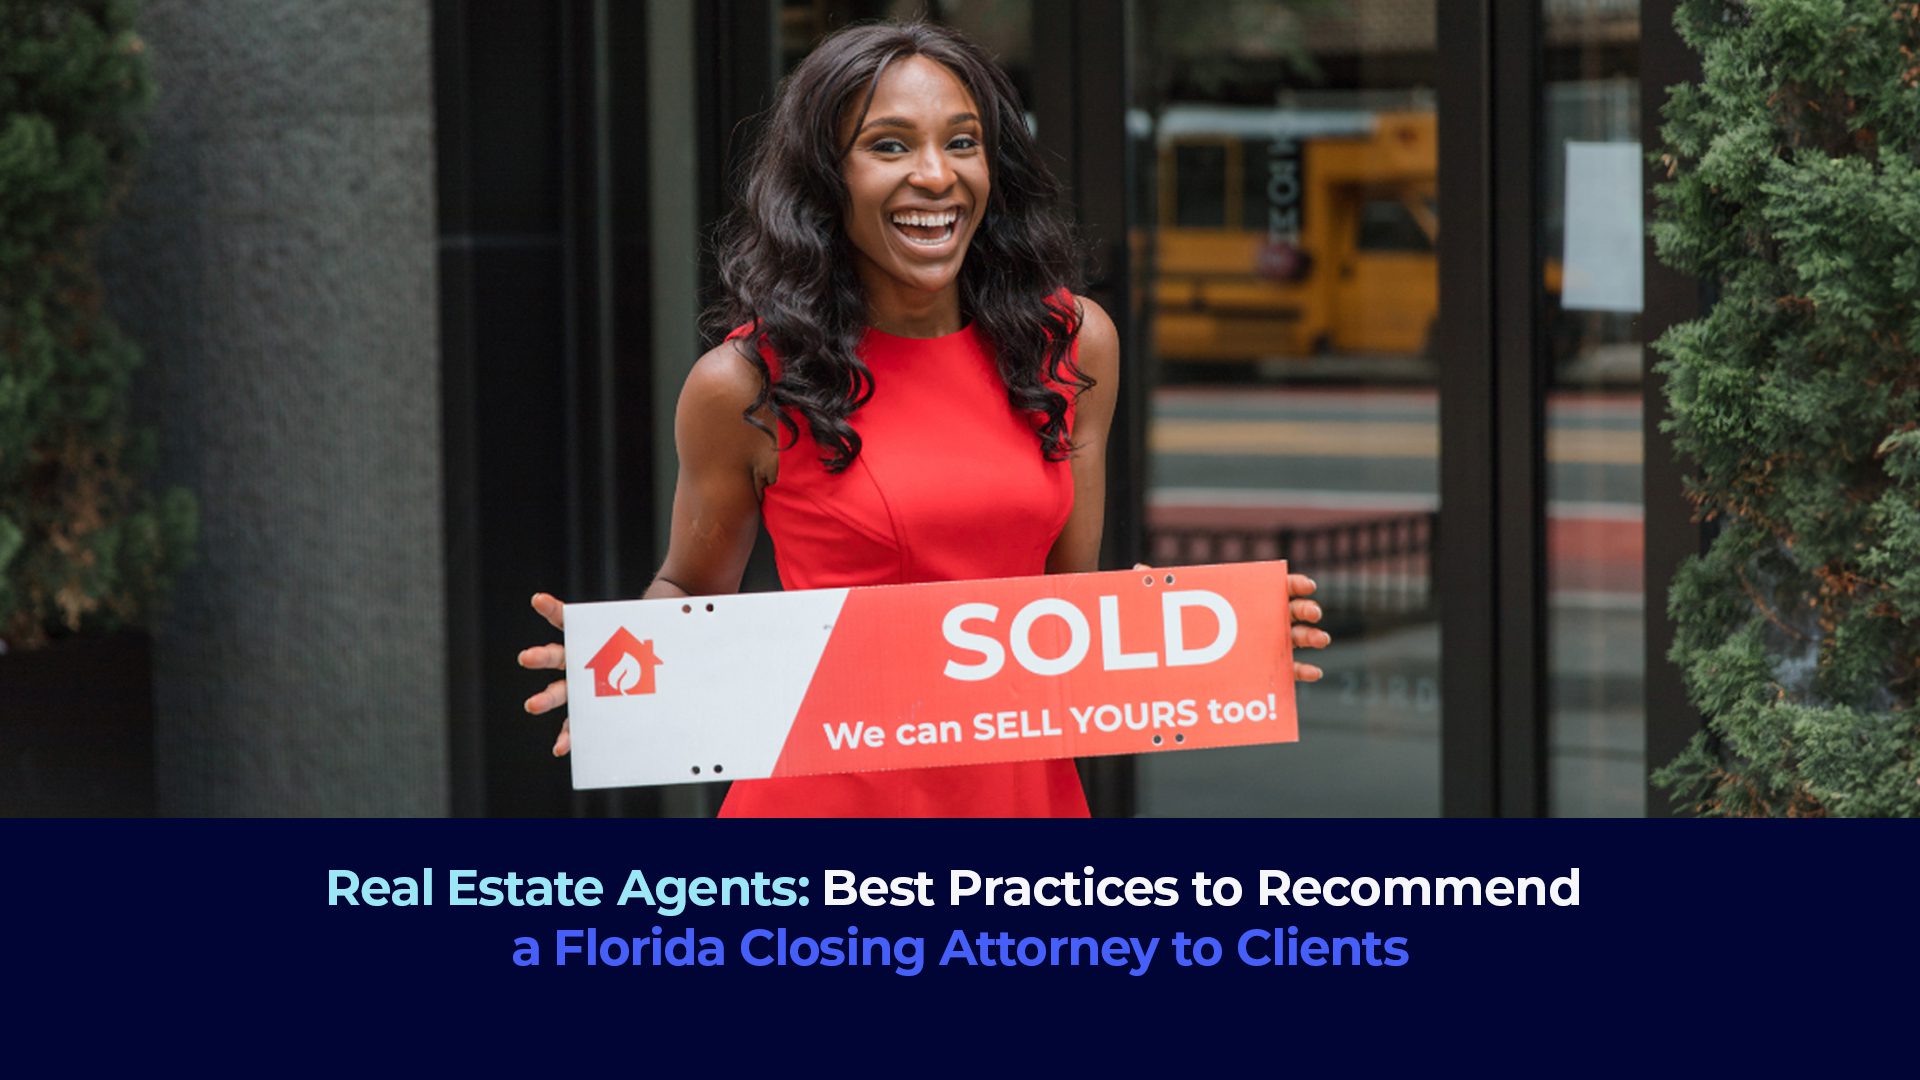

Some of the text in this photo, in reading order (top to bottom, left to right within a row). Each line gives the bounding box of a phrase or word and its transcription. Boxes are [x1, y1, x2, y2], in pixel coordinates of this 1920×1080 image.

[941, 589, 1239, 682] SOLD
[822, 721, 886, 751] We
[895, 720, 963, 746] can
[973, 708, 1063, 741] SELL
[1068, 698, 1199, 734] YOURS
[1206, 692, 1279, 727] too!
